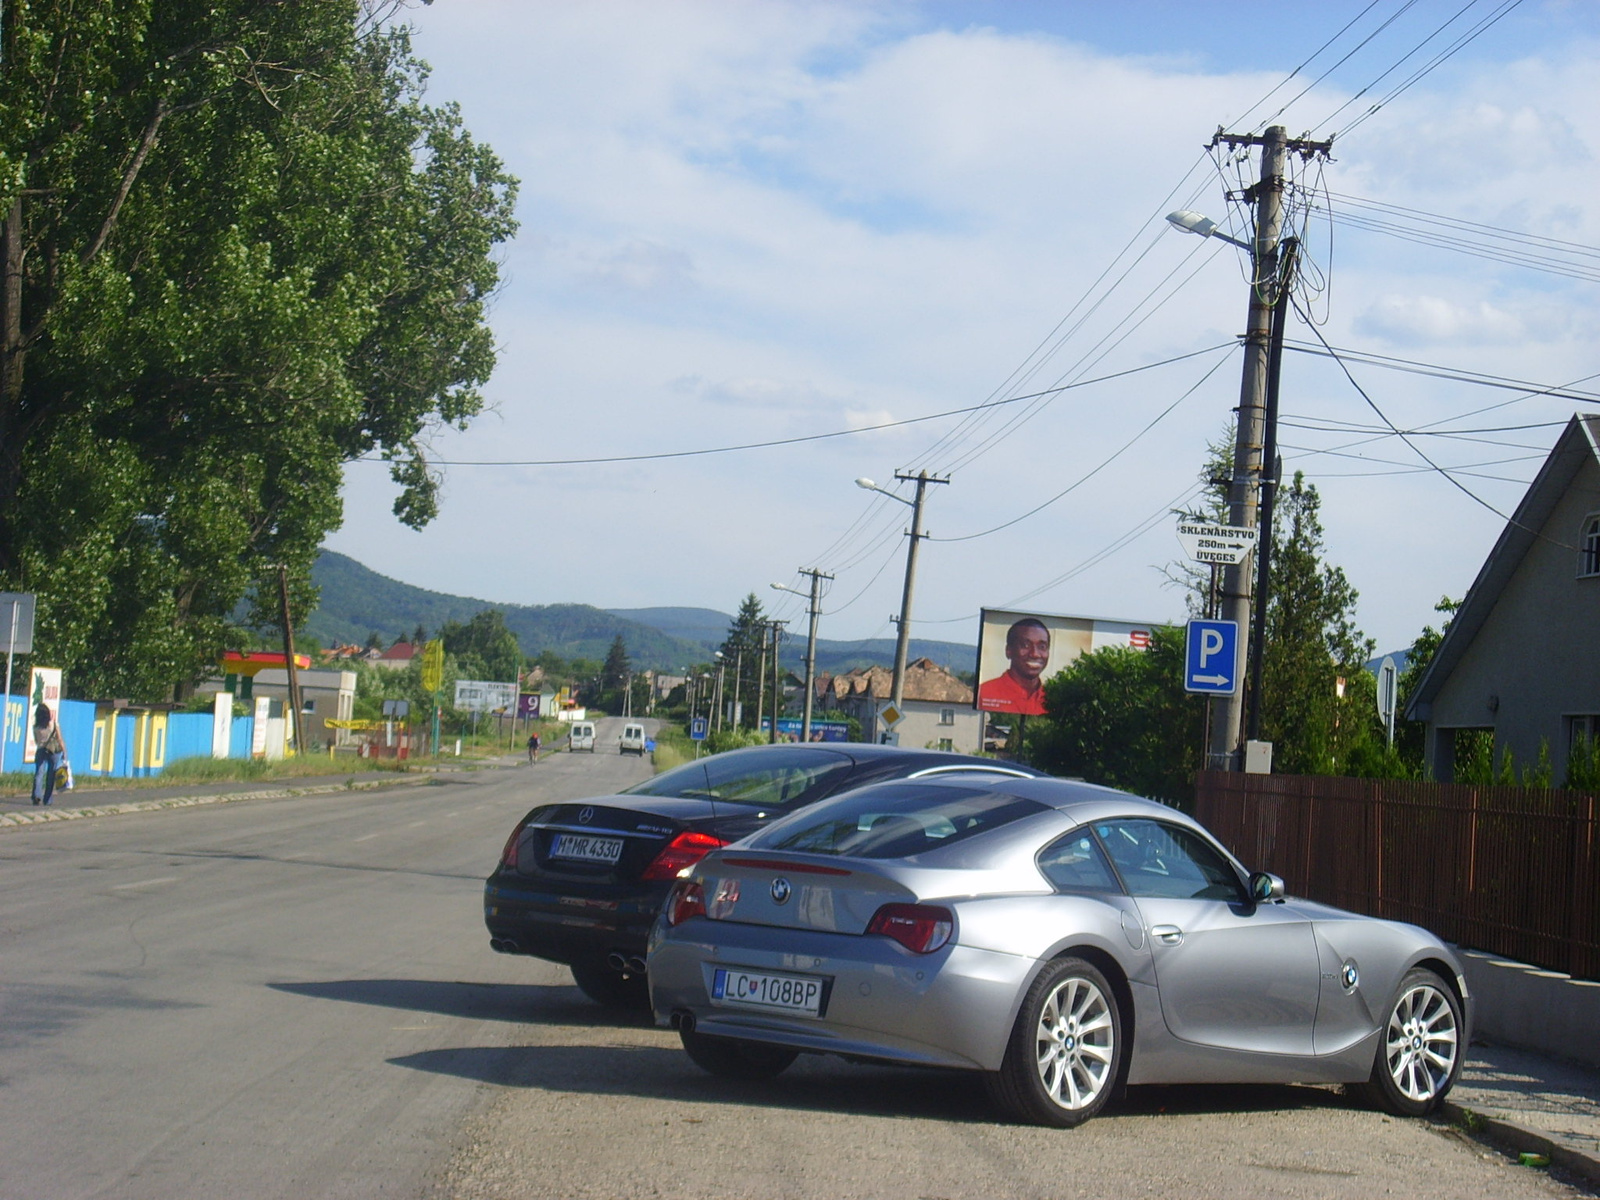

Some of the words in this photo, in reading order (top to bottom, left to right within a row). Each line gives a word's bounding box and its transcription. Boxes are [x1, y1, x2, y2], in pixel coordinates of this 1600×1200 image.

[1198, 539, 1226, 550] 250m
[1130, 630, 1152, 648] S
[1200, 628, 1224, 669] P
[528, 696, 539, 711] 9
[557, 838, 566, 853] M
[571, 840, 588, 855] MR
[589, 841, 620, 859] 4330
[725, 973, 749, 998] LC
[760, 977, 818, 1007] 108BP
